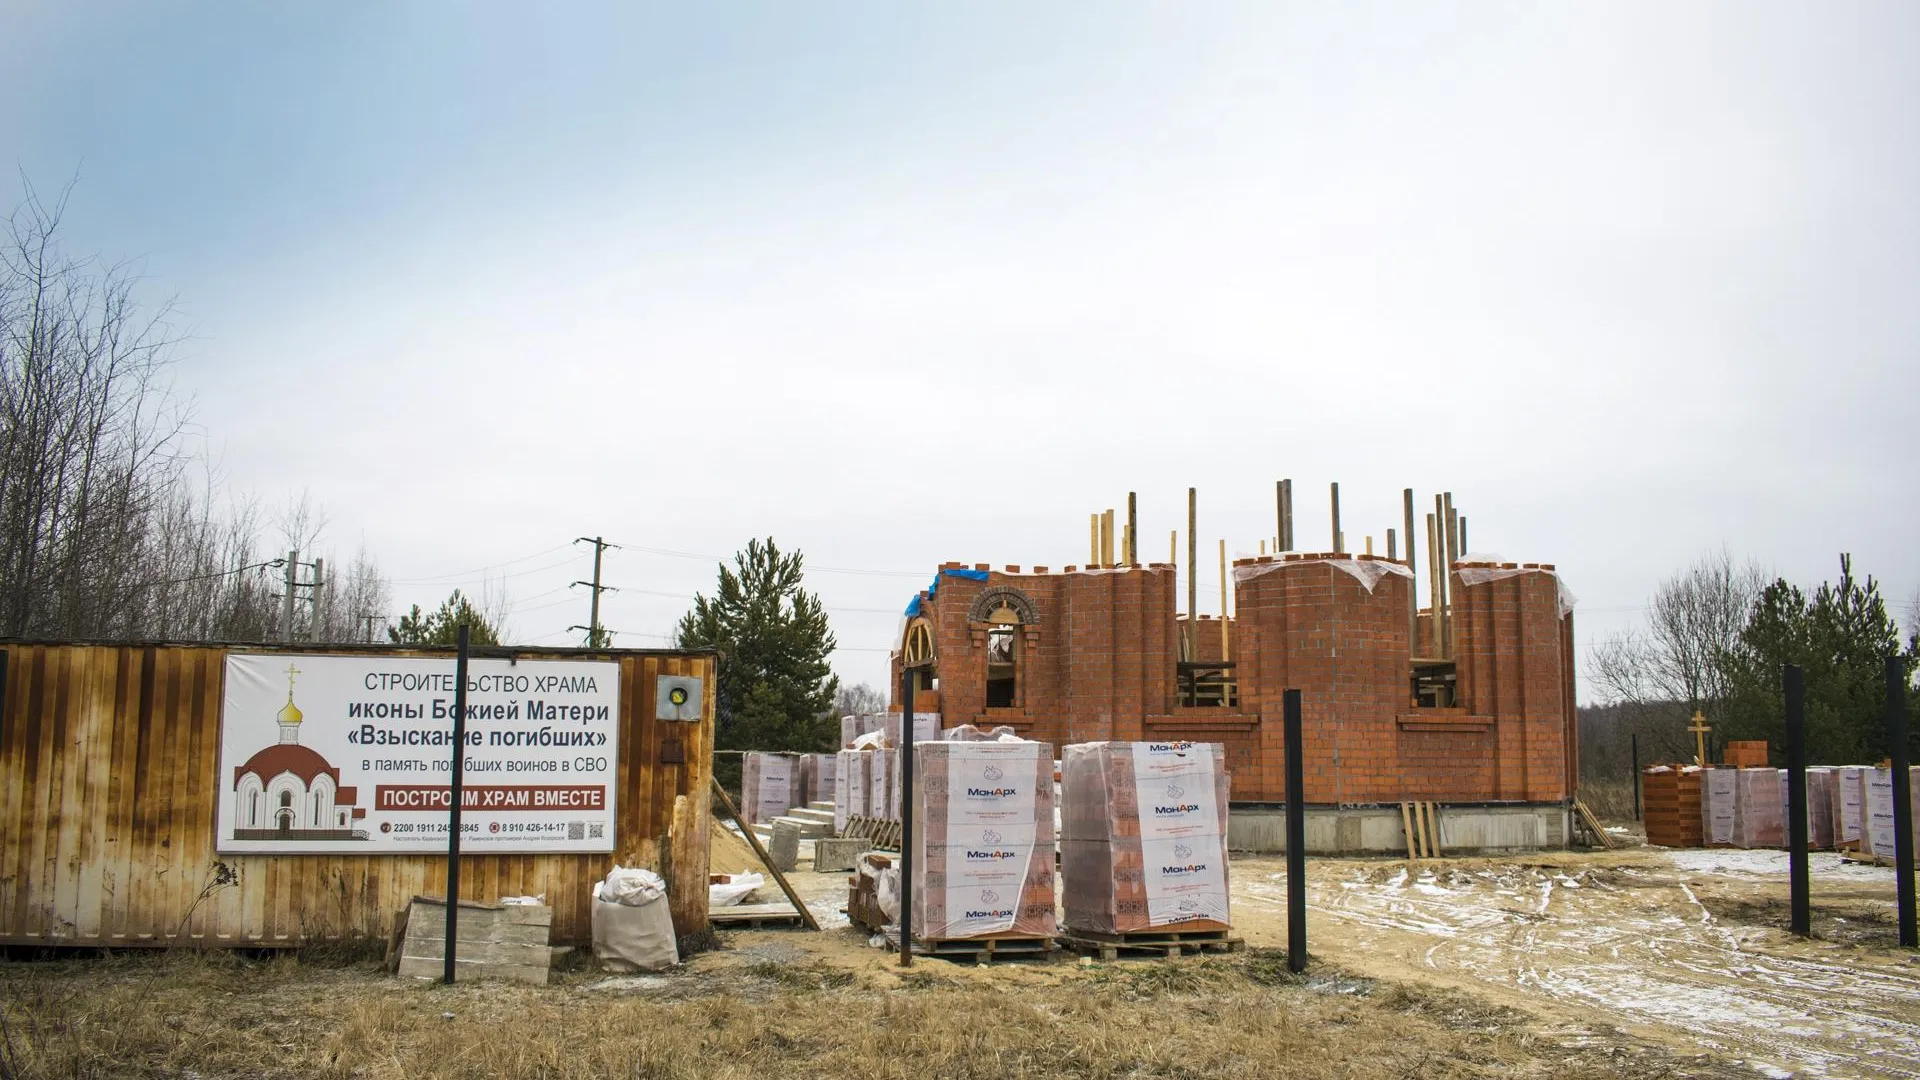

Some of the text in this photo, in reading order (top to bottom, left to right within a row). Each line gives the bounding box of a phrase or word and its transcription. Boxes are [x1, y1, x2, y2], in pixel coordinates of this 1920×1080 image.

[365, 673, 598, 693] СТРОИТЕЬСТВО ХРАМА
[349, 702, 424, 719] иконы
[527, 700, 609, 725] Матери
[490, 726, 607, 746] погибших»
[1149, 743, 1192, 751] МонАрх
[362, 757, 607, 772] в память погбших воинов в СВО
[968, 787, 1016, 797] МонАрх
[483, 790, 529, 806] ХРАМ
[534, 790, 601, 806] ВМЕСТЕ
[1155, 804, 1199, 815] МонАрх
[394, 823, 414, 832] 2200
[417, 823, 435, 832] 1911
[502, 823, 566, 832] 8 910 426-14-17
[967, 850, 1015, 860] МонАрх
[1162, 864, 1207, 874] МонАрх
[965, 910, 1013, 918] МонАрх
